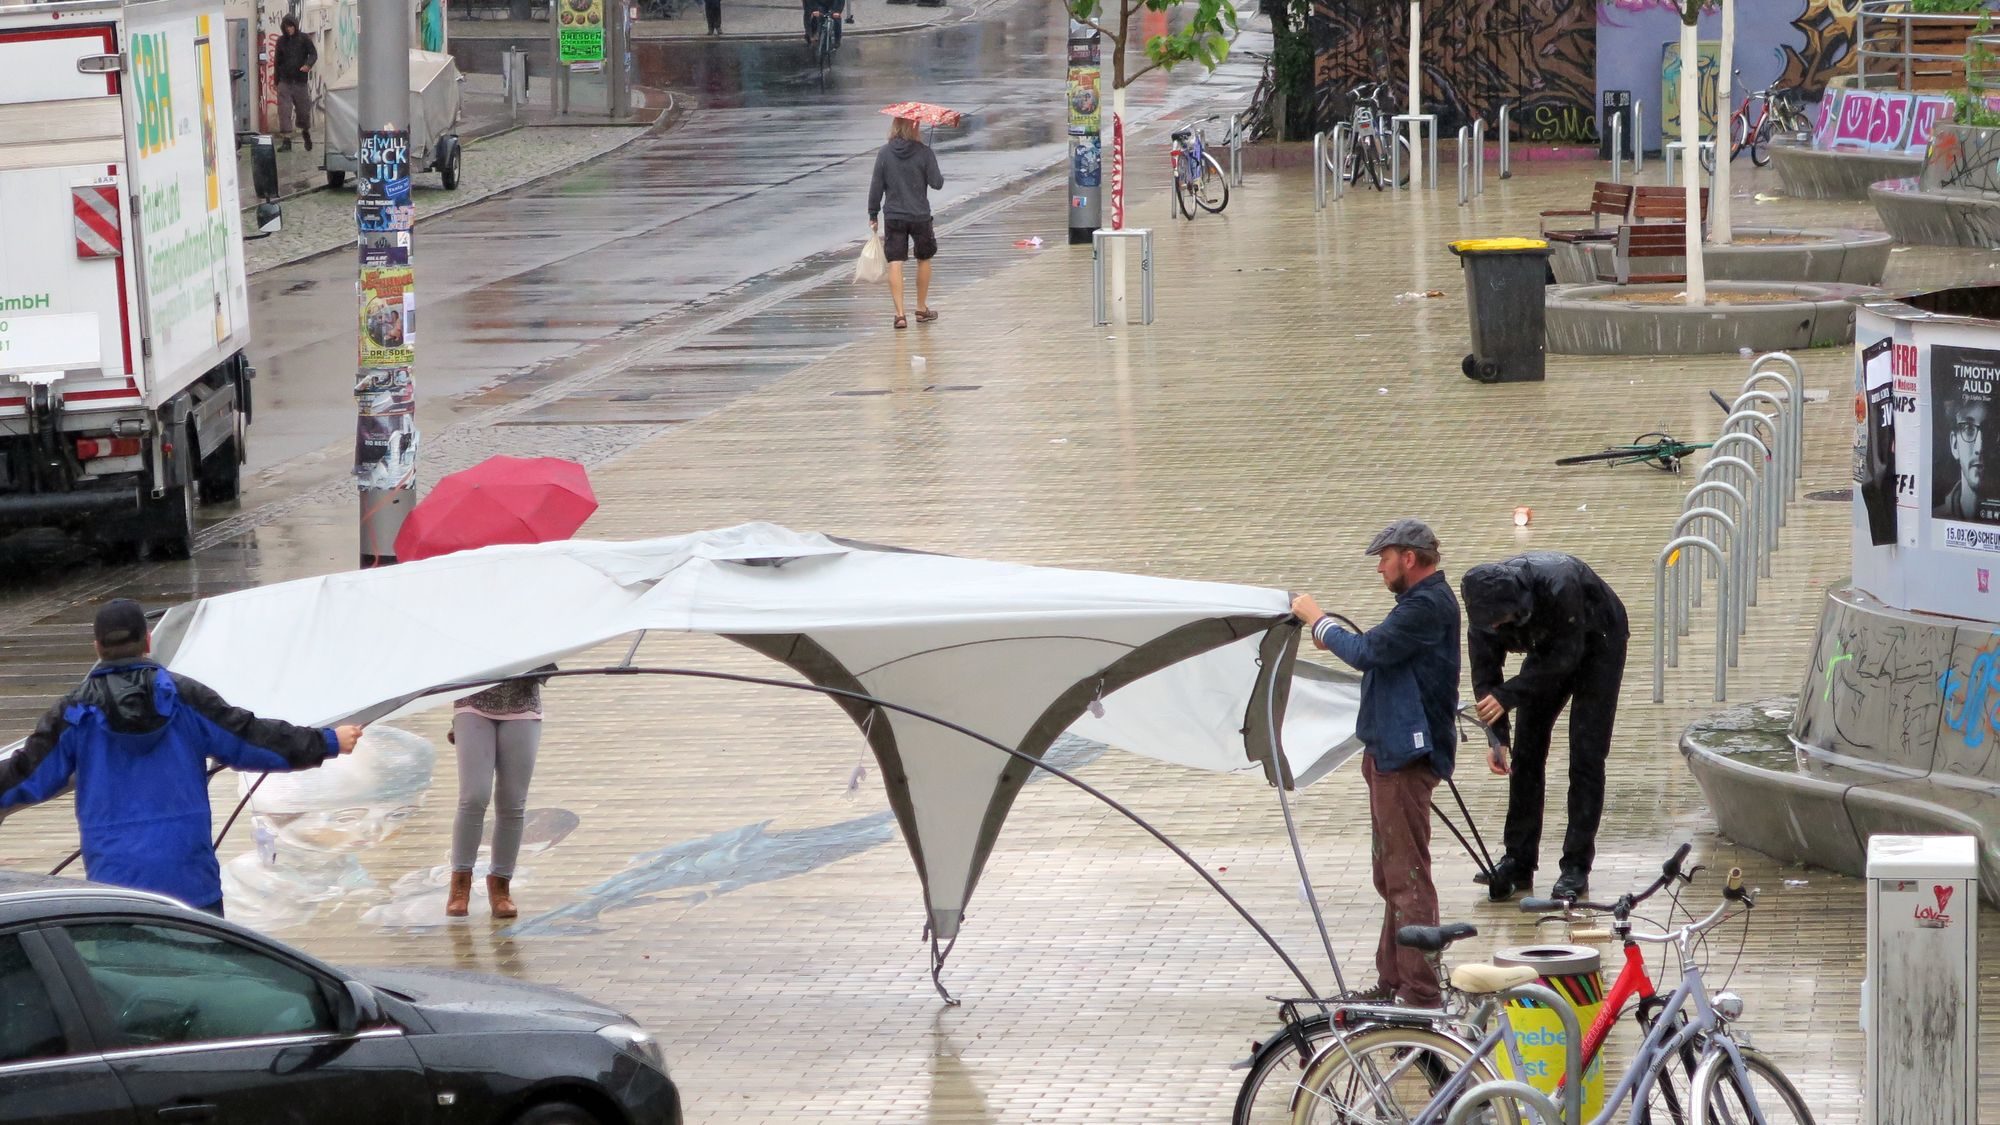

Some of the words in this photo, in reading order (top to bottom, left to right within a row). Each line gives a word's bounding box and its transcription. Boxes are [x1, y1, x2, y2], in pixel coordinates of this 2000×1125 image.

[131, 31, 175, 156] SBH
[360, 138, 374, 148] WE
[378, 137, 407, 149] WILL
[370, 164, 398, 183] JU
[1953, 365, 2000, 381] TIMOTHY
[1962, 380, 1992, 394] AULD
[1914, 904, 1951, 924] LOVE
